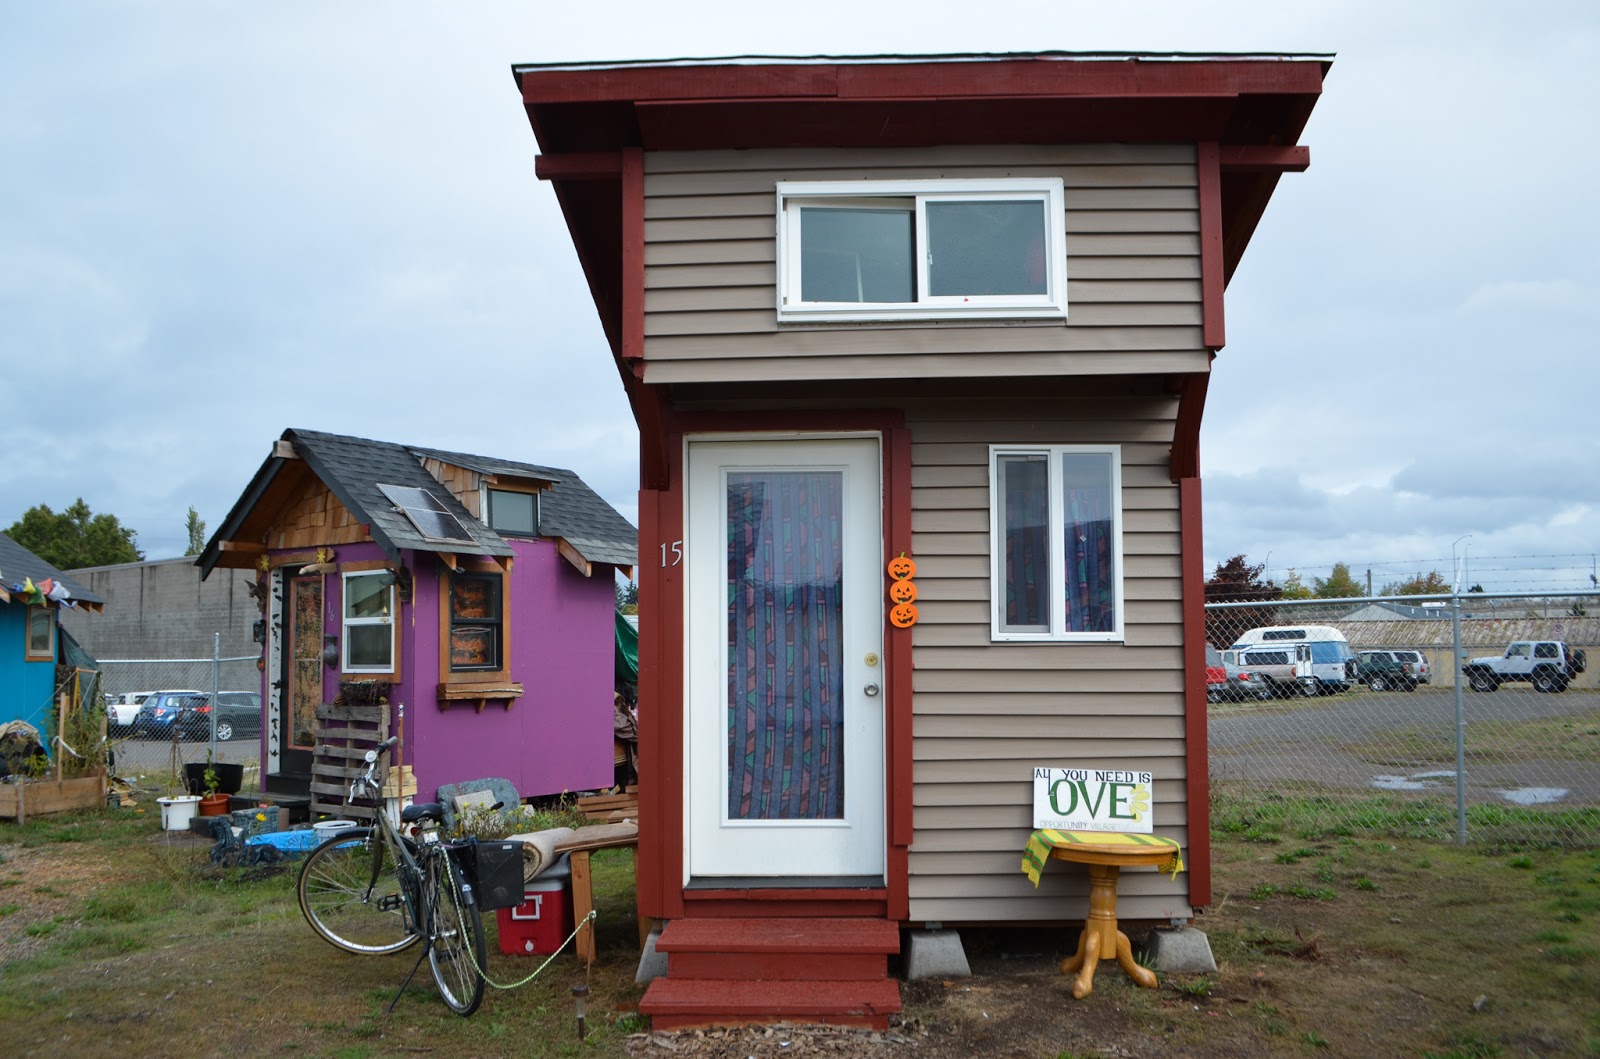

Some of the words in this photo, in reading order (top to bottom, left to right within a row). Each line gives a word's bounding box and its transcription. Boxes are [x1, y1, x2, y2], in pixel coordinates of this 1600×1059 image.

[660, 540, 683, 567] 15
[1062, 769, 1088, 781] YOU
[1096, 771, 1134, 783] NEED
[1139, 772, 1151, 783] IS
[1039, 819, 1088, 829] OPPORTUNITY
[1090, 822, 1117, 831] VILLAGE
